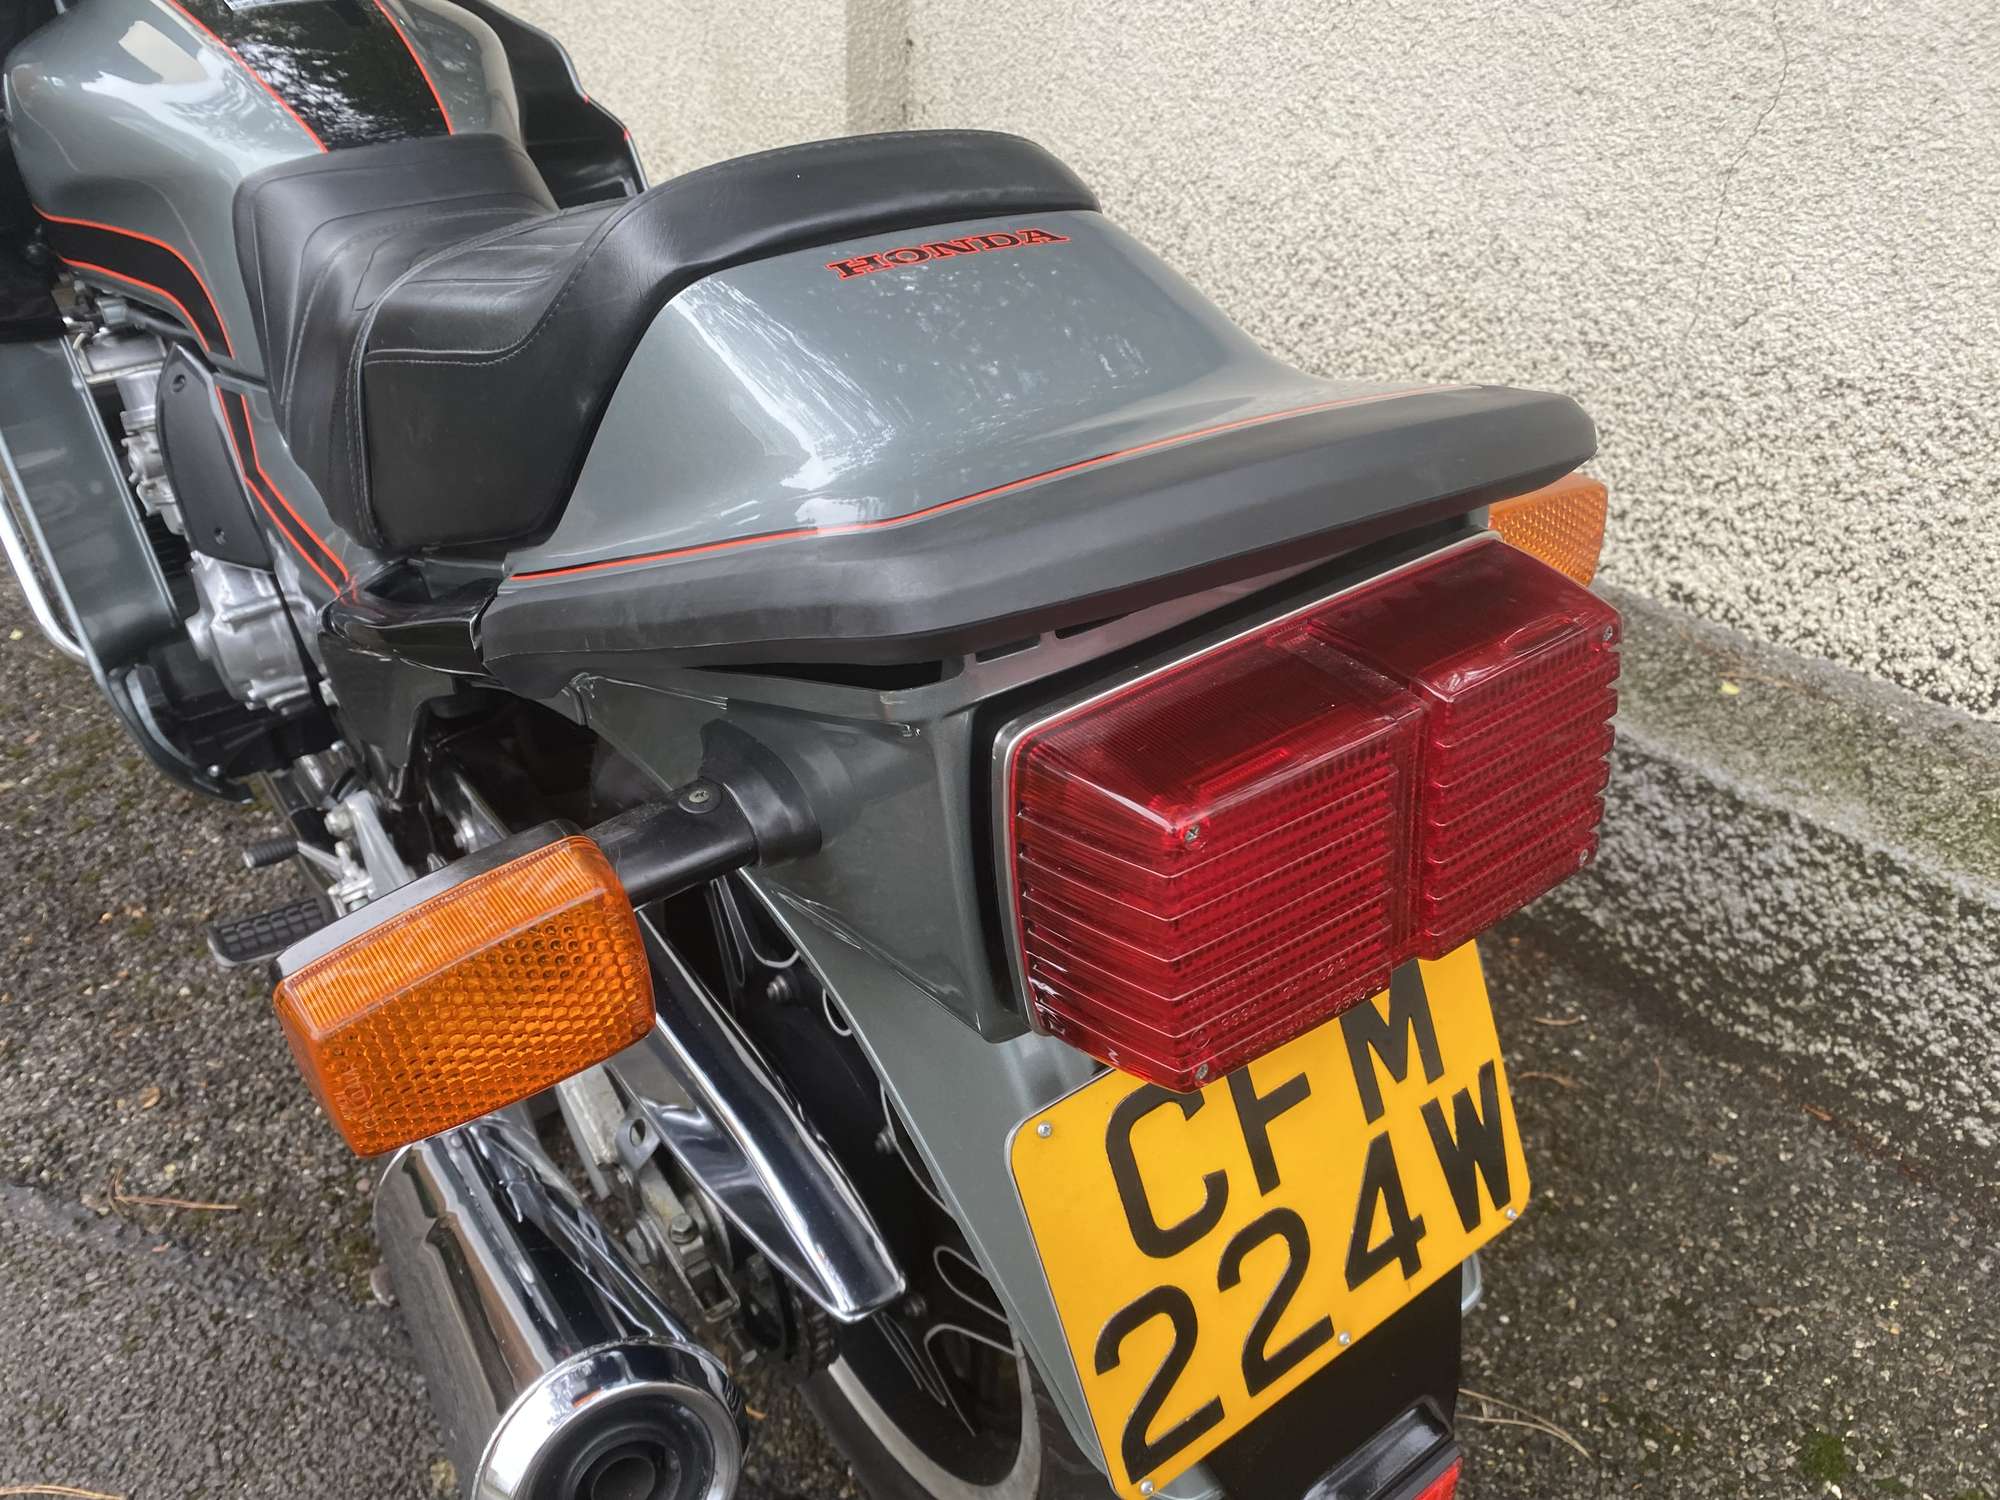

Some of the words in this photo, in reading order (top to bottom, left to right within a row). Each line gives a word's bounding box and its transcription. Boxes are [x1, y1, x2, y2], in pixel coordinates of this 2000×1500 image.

[825, 228, 1071, 280] HONDA
[1105, 958, 1445, 1260] CFM
[1094, 1060, 1512, 1486] 224W
